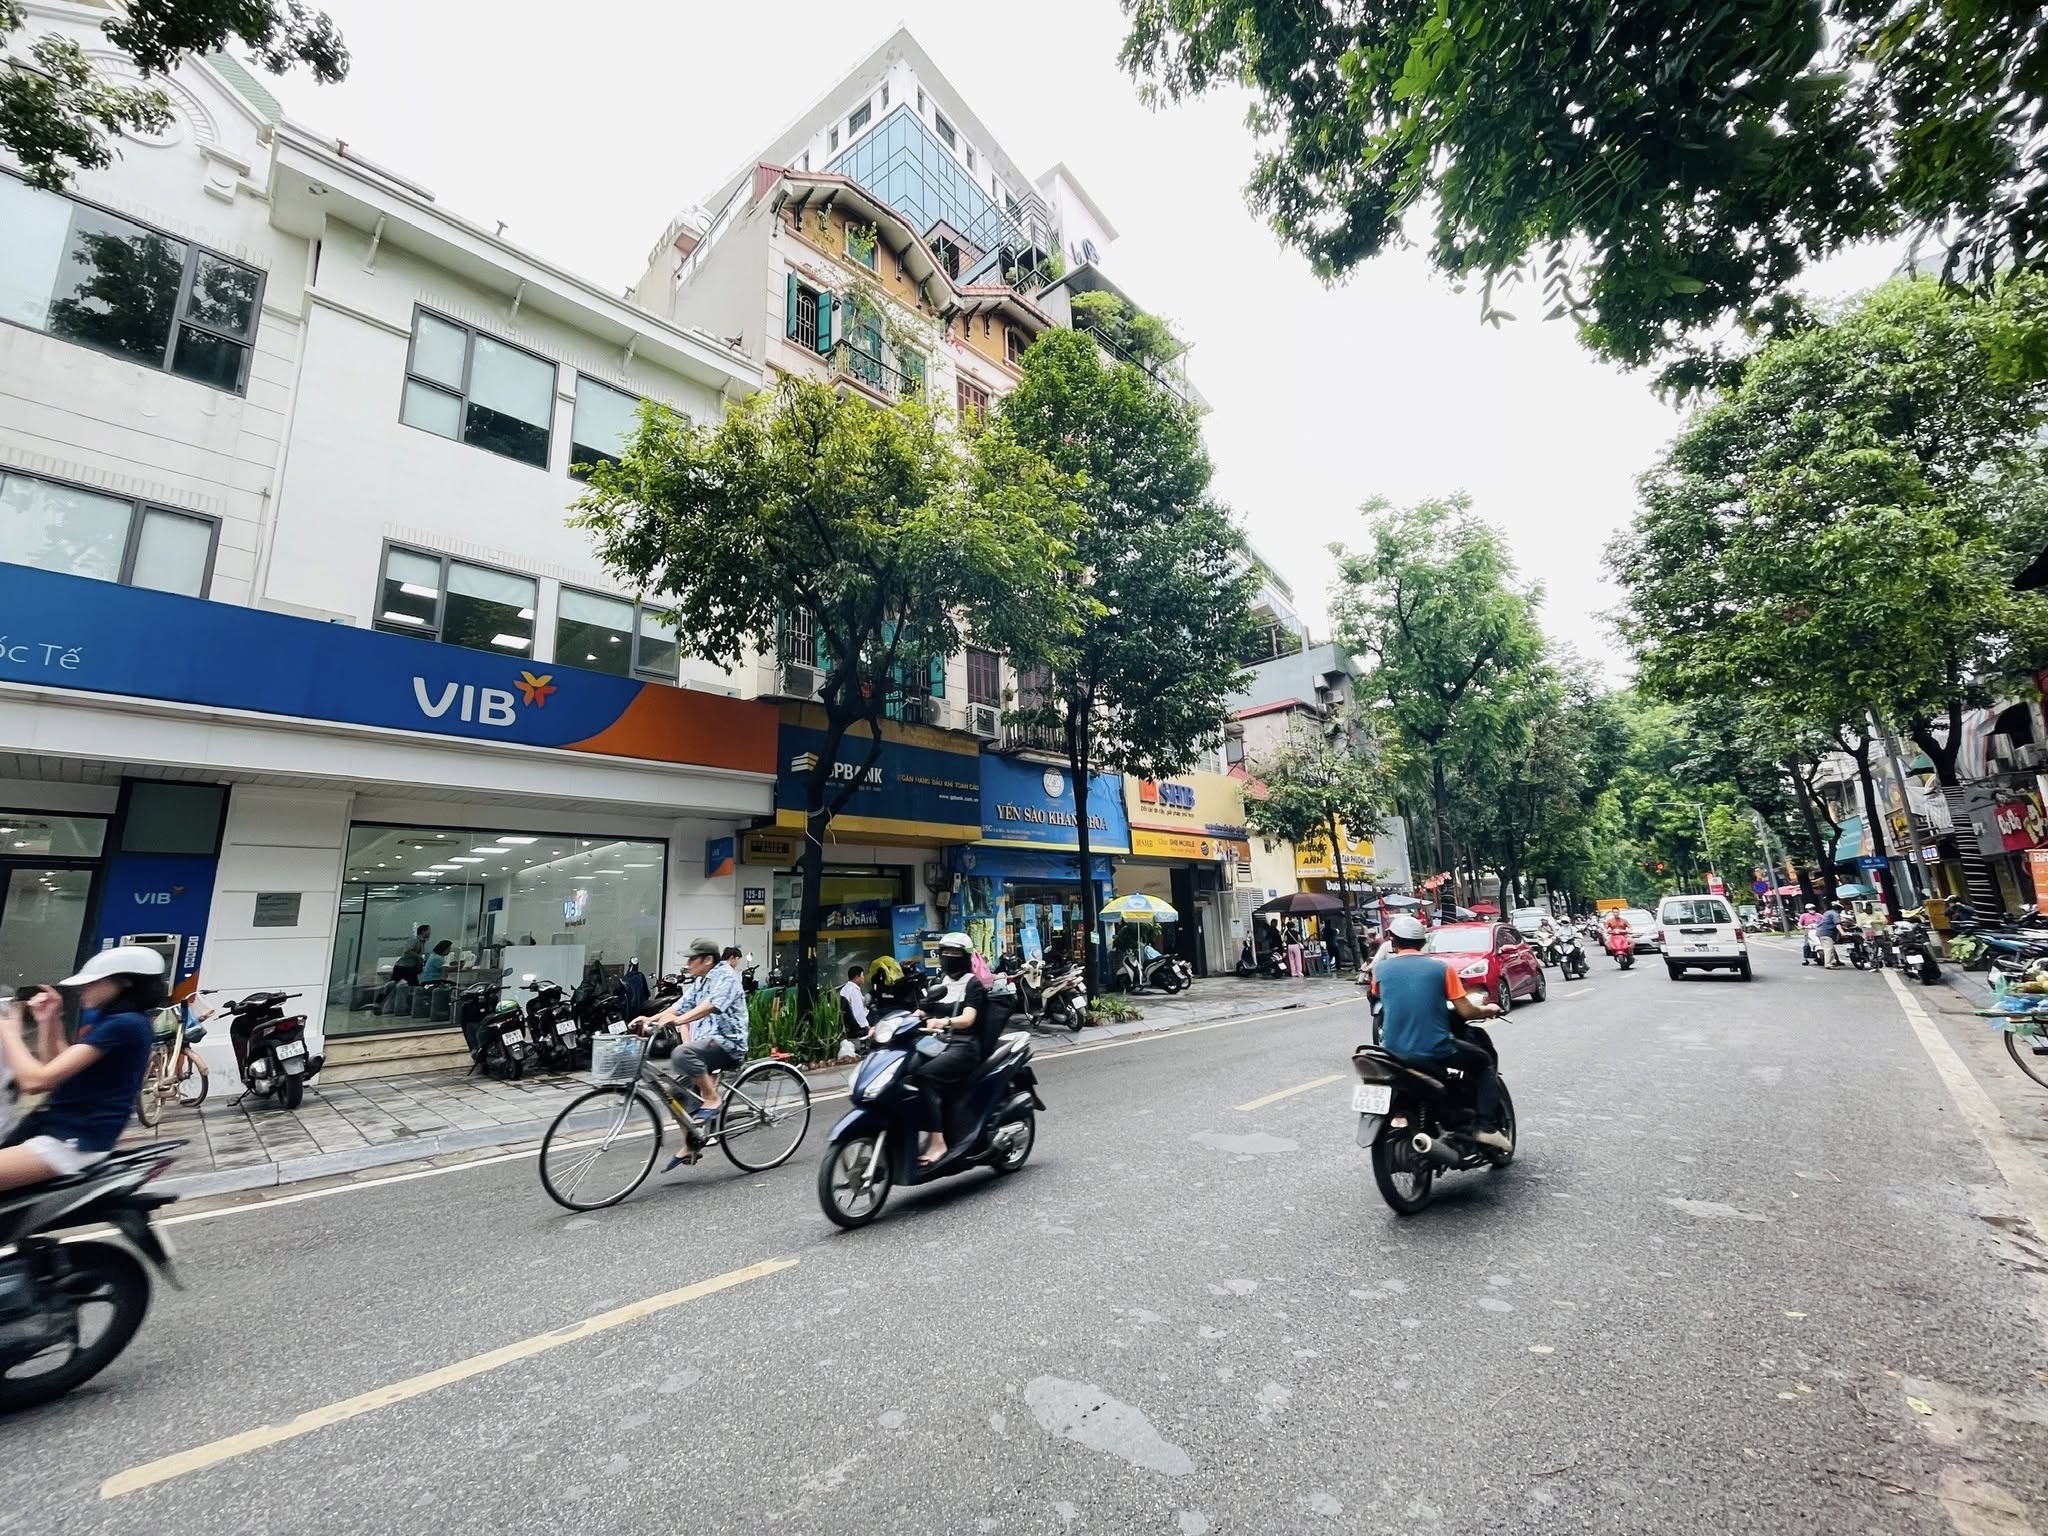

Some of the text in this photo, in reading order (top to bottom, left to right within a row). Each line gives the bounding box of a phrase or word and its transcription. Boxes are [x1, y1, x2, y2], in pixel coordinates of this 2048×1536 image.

[38, 642, 83, 670] Tế
[413, 676, 516, 727] VIB
[829, 761, 882, 783] PBNK
[1159, 783, 1196, 809] SHB
[997, 801, 1021, 821] YẾN
[1024, 805, 1045, 824] SÀO
[134, 892, 171, 905] VIB
